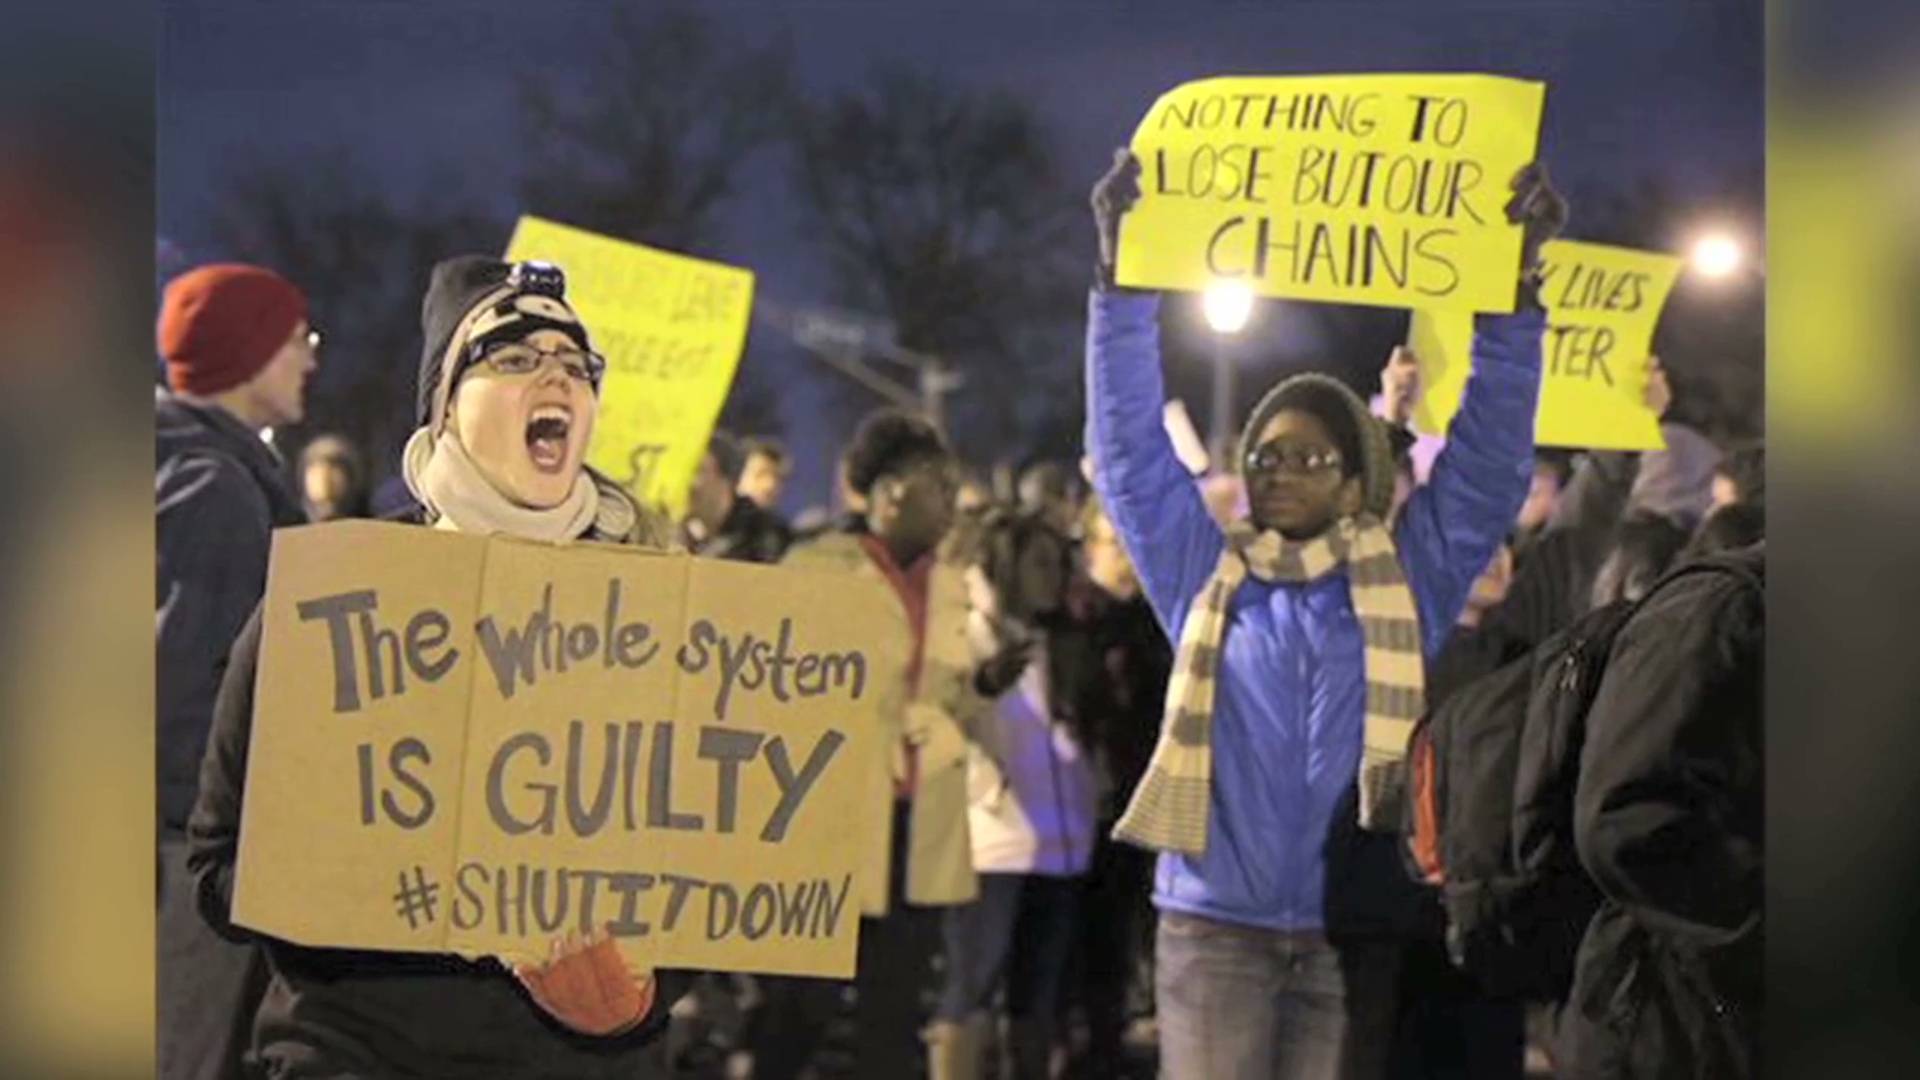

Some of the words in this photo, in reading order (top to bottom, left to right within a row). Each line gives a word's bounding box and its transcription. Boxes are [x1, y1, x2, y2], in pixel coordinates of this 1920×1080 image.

[1159, 92, 1380, 137] NOTHING
[1408, 94, 1468, 149] TO
[1156, 143, 1277, 204] LOSE
[1205, 215, 1460, 297] CHAINS
[1557, 262, 1652, 313] LIVES
[296, 589, 460, 713] The
[475, 578, 660, 700] whole
[676, 618, 867, 721] system
[356, 736, 435, 829] IS
[484, 719, 846, 843] GUILTY
